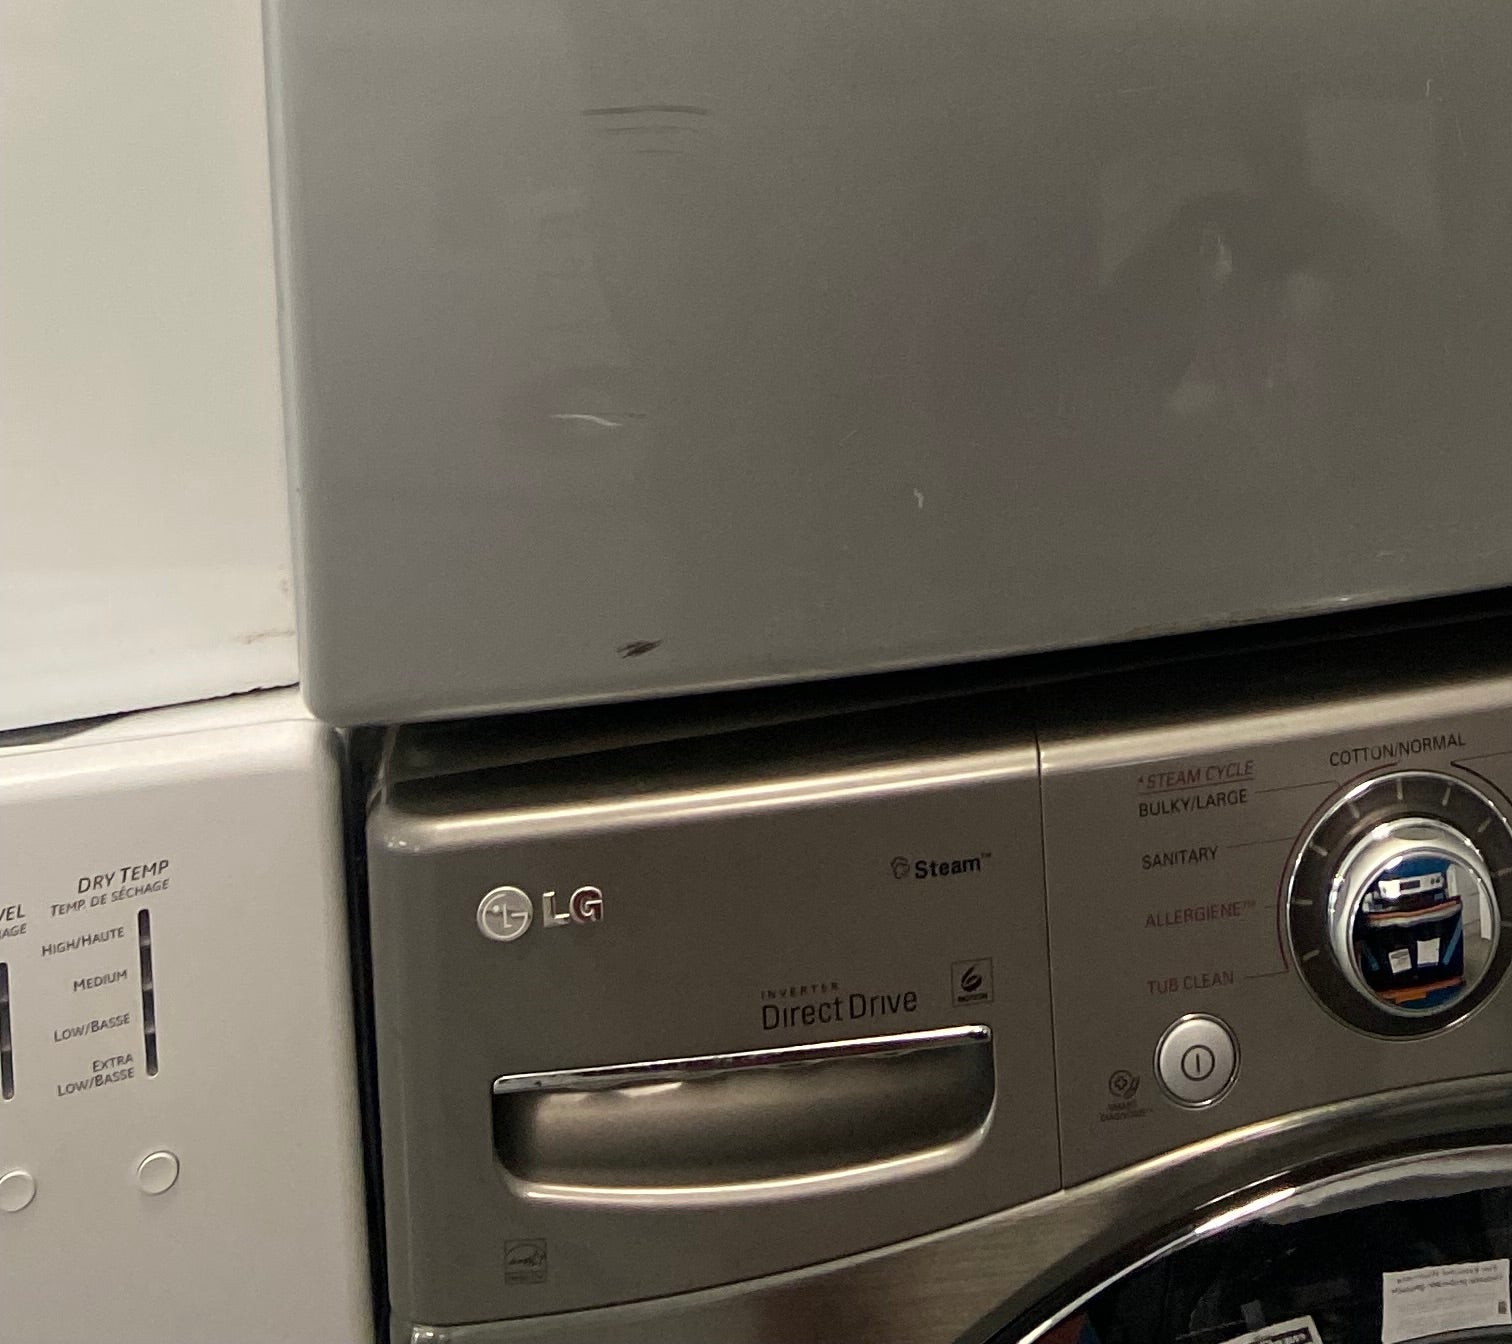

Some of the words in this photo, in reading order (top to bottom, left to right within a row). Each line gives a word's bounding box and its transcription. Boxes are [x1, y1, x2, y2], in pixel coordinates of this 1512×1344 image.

[1329, 733, 1466, 768] COTTON/NORMAL
[1204, 761, 1255, 781] CYCLE
[1138, 788, 1248, 818] BULKY/LARGE
[1141, 846, 1219, 870] SANITARY
[77, 870, 116, 895] DRY
[119, 859, 170, 885] TEMP
[89, 893, 108, 909] DE
[111, 877, 171, 904] SÉCHAGE
[541, 885, 604, 928] LG
[42, 926, 125, 957] HIGH/HAUTE
[73, 968, 129, 993] MEDIUM
[760, 982, 840, 1001] INVERTER
[1147, 976, 1178, 995] TUB
[1183, 970, 1234, 990] CLEAN
[762, 996, 843, 1031] Direct
[849, 991, 918, 1020] Drive
[53, 1012, 131, 1044] LOW/BASSE
[92, 1052, 134, 1074] EXTRA
[57, 1066, 135, 1097] LOW/BASSE
